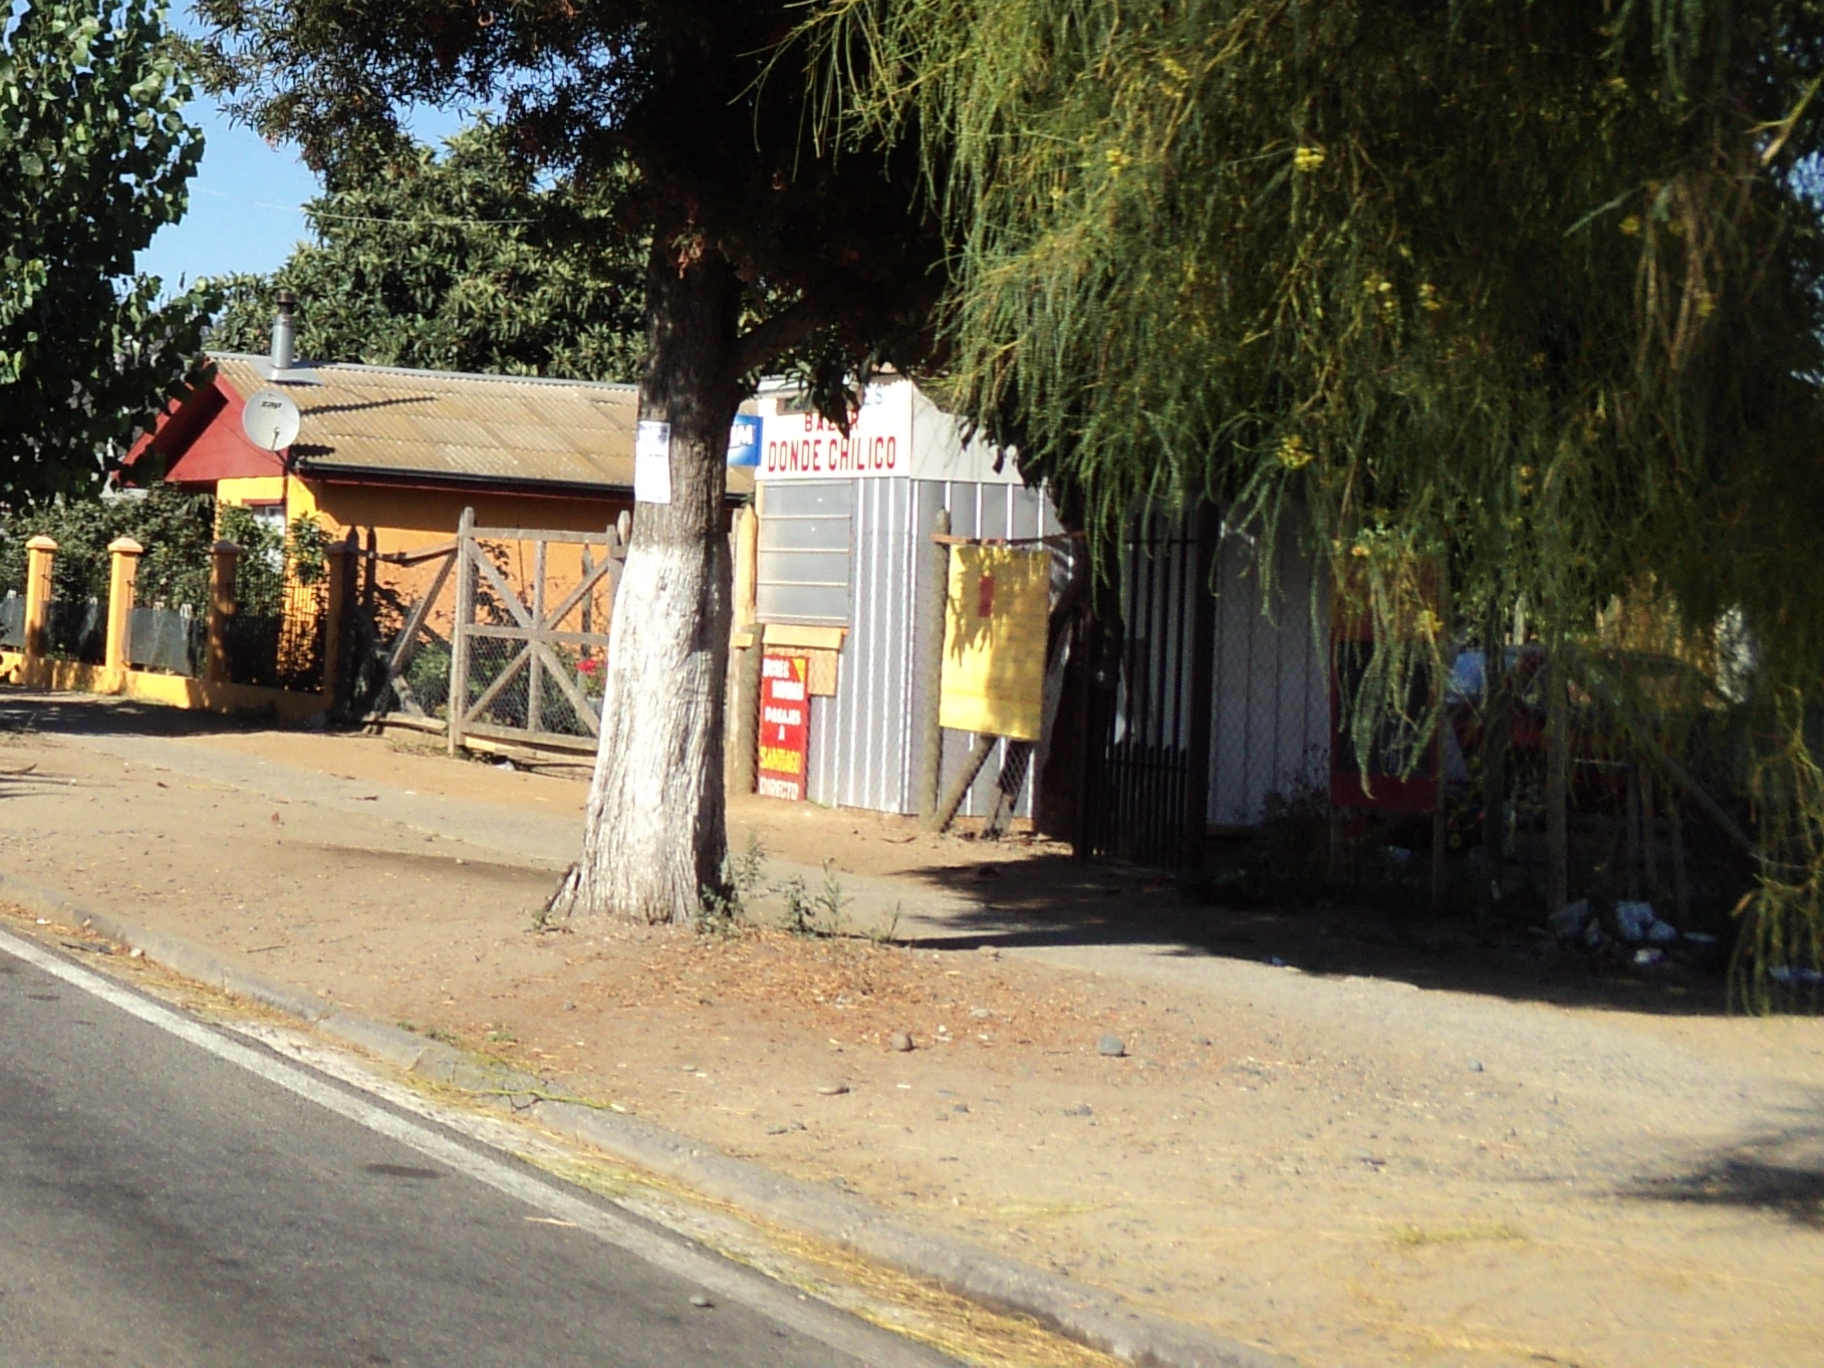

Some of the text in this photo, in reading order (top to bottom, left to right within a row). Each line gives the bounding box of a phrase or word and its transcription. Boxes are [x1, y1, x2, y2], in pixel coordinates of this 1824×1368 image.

[804, 410, 859, 432] BAZR
[768, 436, 896, 472] DONDE CHILICO
[760, 745, 802, 774] SANTIAGO
[759, 776, 799, 801] DIRECTO
